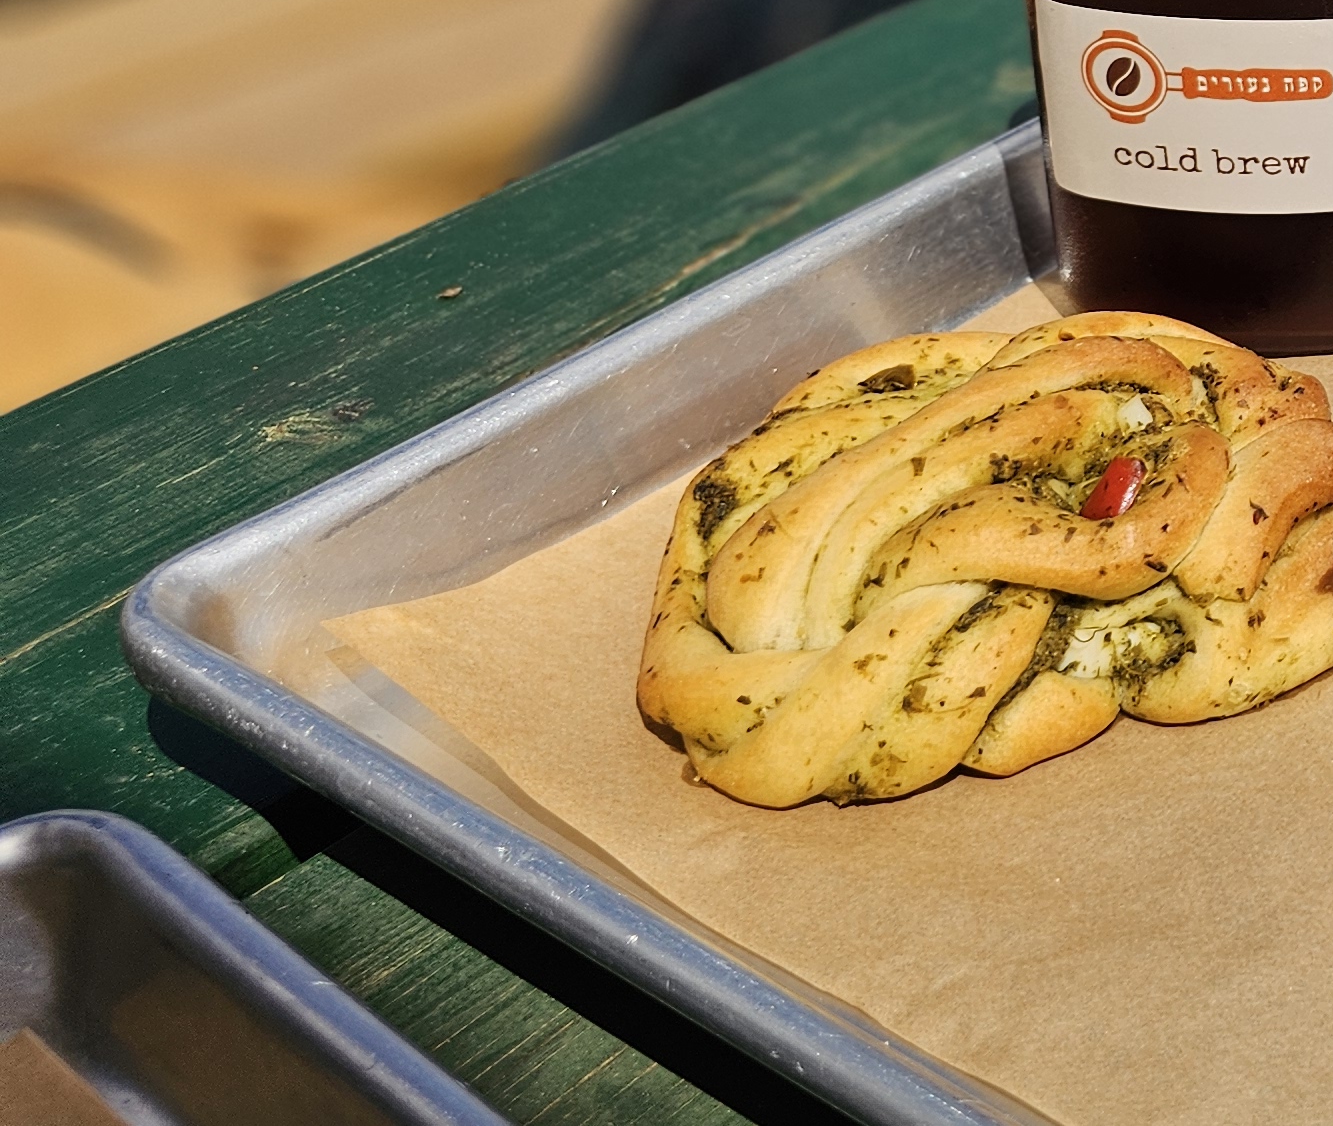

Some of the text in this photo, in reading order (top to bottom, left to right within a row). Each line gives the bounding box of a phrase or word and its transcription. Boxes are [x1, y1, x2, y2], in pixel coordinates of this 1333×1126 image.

[1197, 75, 1323, 94] קפה נעורים
[1113, 145, 1311, 175] cold brew
